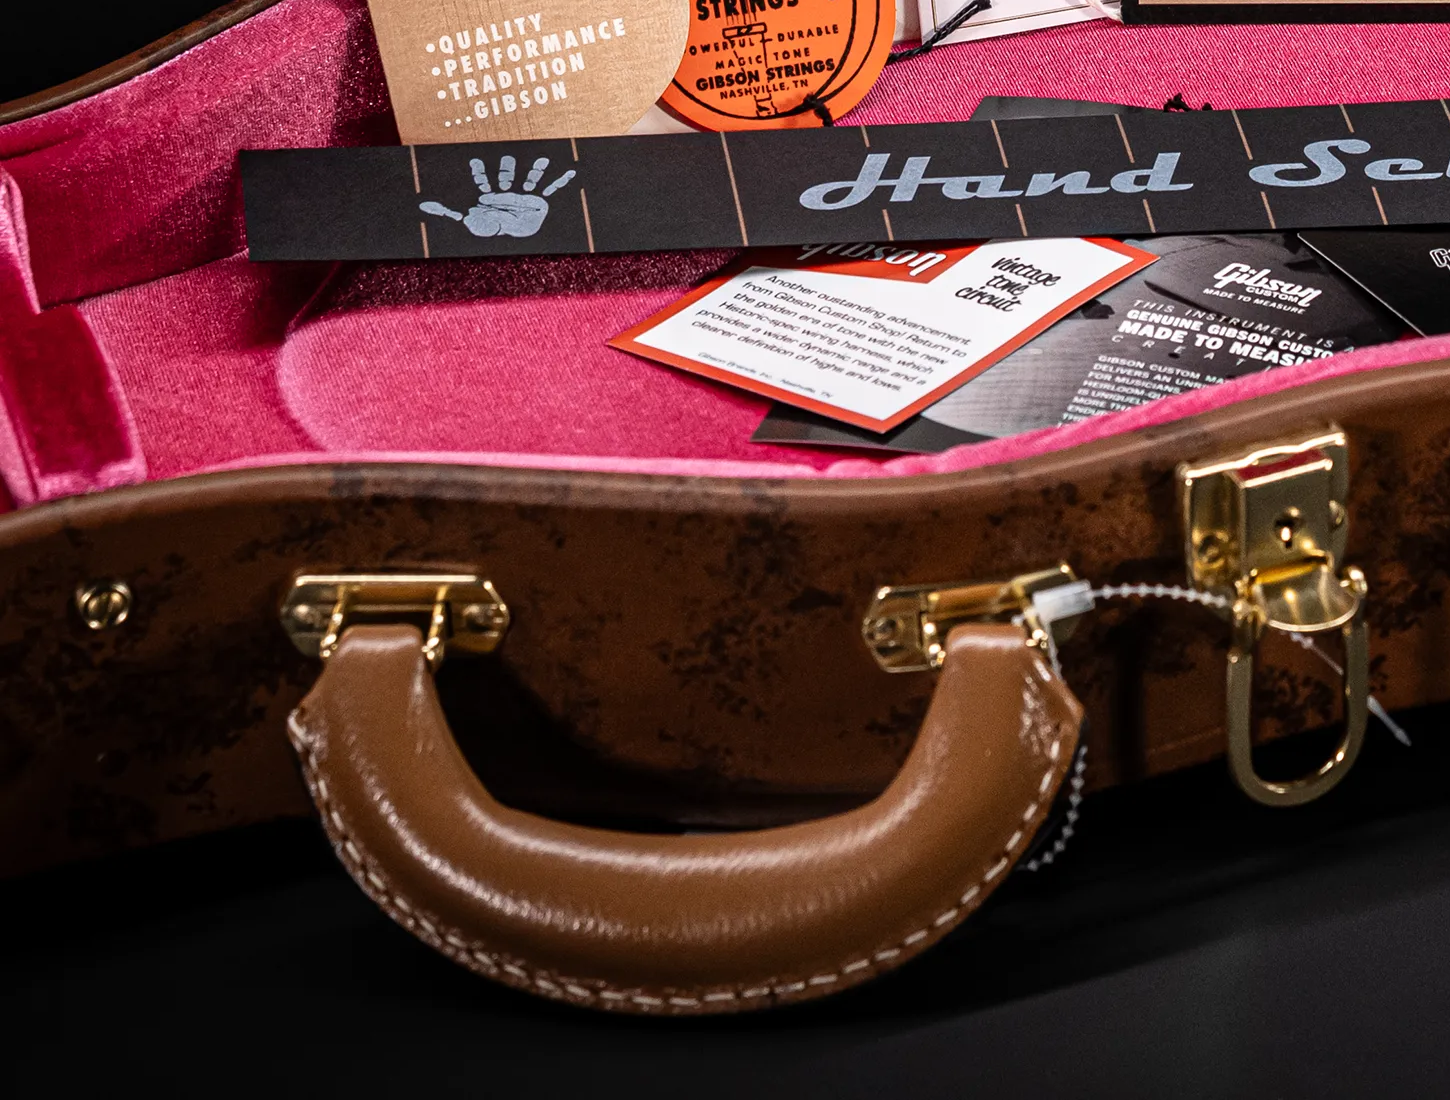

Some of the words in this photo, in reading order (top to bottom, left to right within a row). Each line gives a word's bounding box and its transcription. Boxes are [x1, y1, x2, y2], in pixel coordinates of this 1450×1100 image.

[689, 36, 755, 57] OWERFUL
[777, 24, 839, 43] DURABLE
[715, 55, 763, 71] MAGIC
[773, 47, 811, 61] TONE
[695, 69, 760, 92] GIBSON
[766, 58, 836, 81] STRINGS
[720, 81, 790, 100] NASHVILLE,
[792, 79, 809, 89] TN
[800, 152, 1194, 211] Hand
[986, 274, 1029, 296] tone
[991, 257, 1061, 287] vintage
[1213, 262, 1322, 307] Gibson
[754, 300, 798, 318] golden
[955, 285, 1023, 313] circuit
[1203, 288, 1236, 300] MADE
[1237, 294, 1252, 302] TO
[1253, 298, 1307, 315] MEASURE
[1245, 286, 1299, 303] CUSTOM
[742, 281, 773, 297] from
[774, 291, 817, 311] Gibson
[818, 305, 867, 326] Custom
[906, 333, 951, 354] Return
[766, 275, 817, 296] Another
[887, 315, 972, 346] advancement
[1133, 299, 1174, 313] THIS
[1185, 309, 1308, 340] INSTRUMENT
[692, 320, 738, 338] clearer
[738, 335, 795, 357] definition
[696, 309, 753, 330] provides
[763, 330, 799, 345] wider
[799, 341, 852, 363] dynamic
[802, 328, 840, 346] wiring
[1118, 320, 1188, 343] MADE
[1194, 333, 1224, 350] TO
[1126, 309, 1203, 332] GENUINE
[1207, 324, 1273, 346] GIBSON
[1278, 339, 1334, 358] CUSTO
